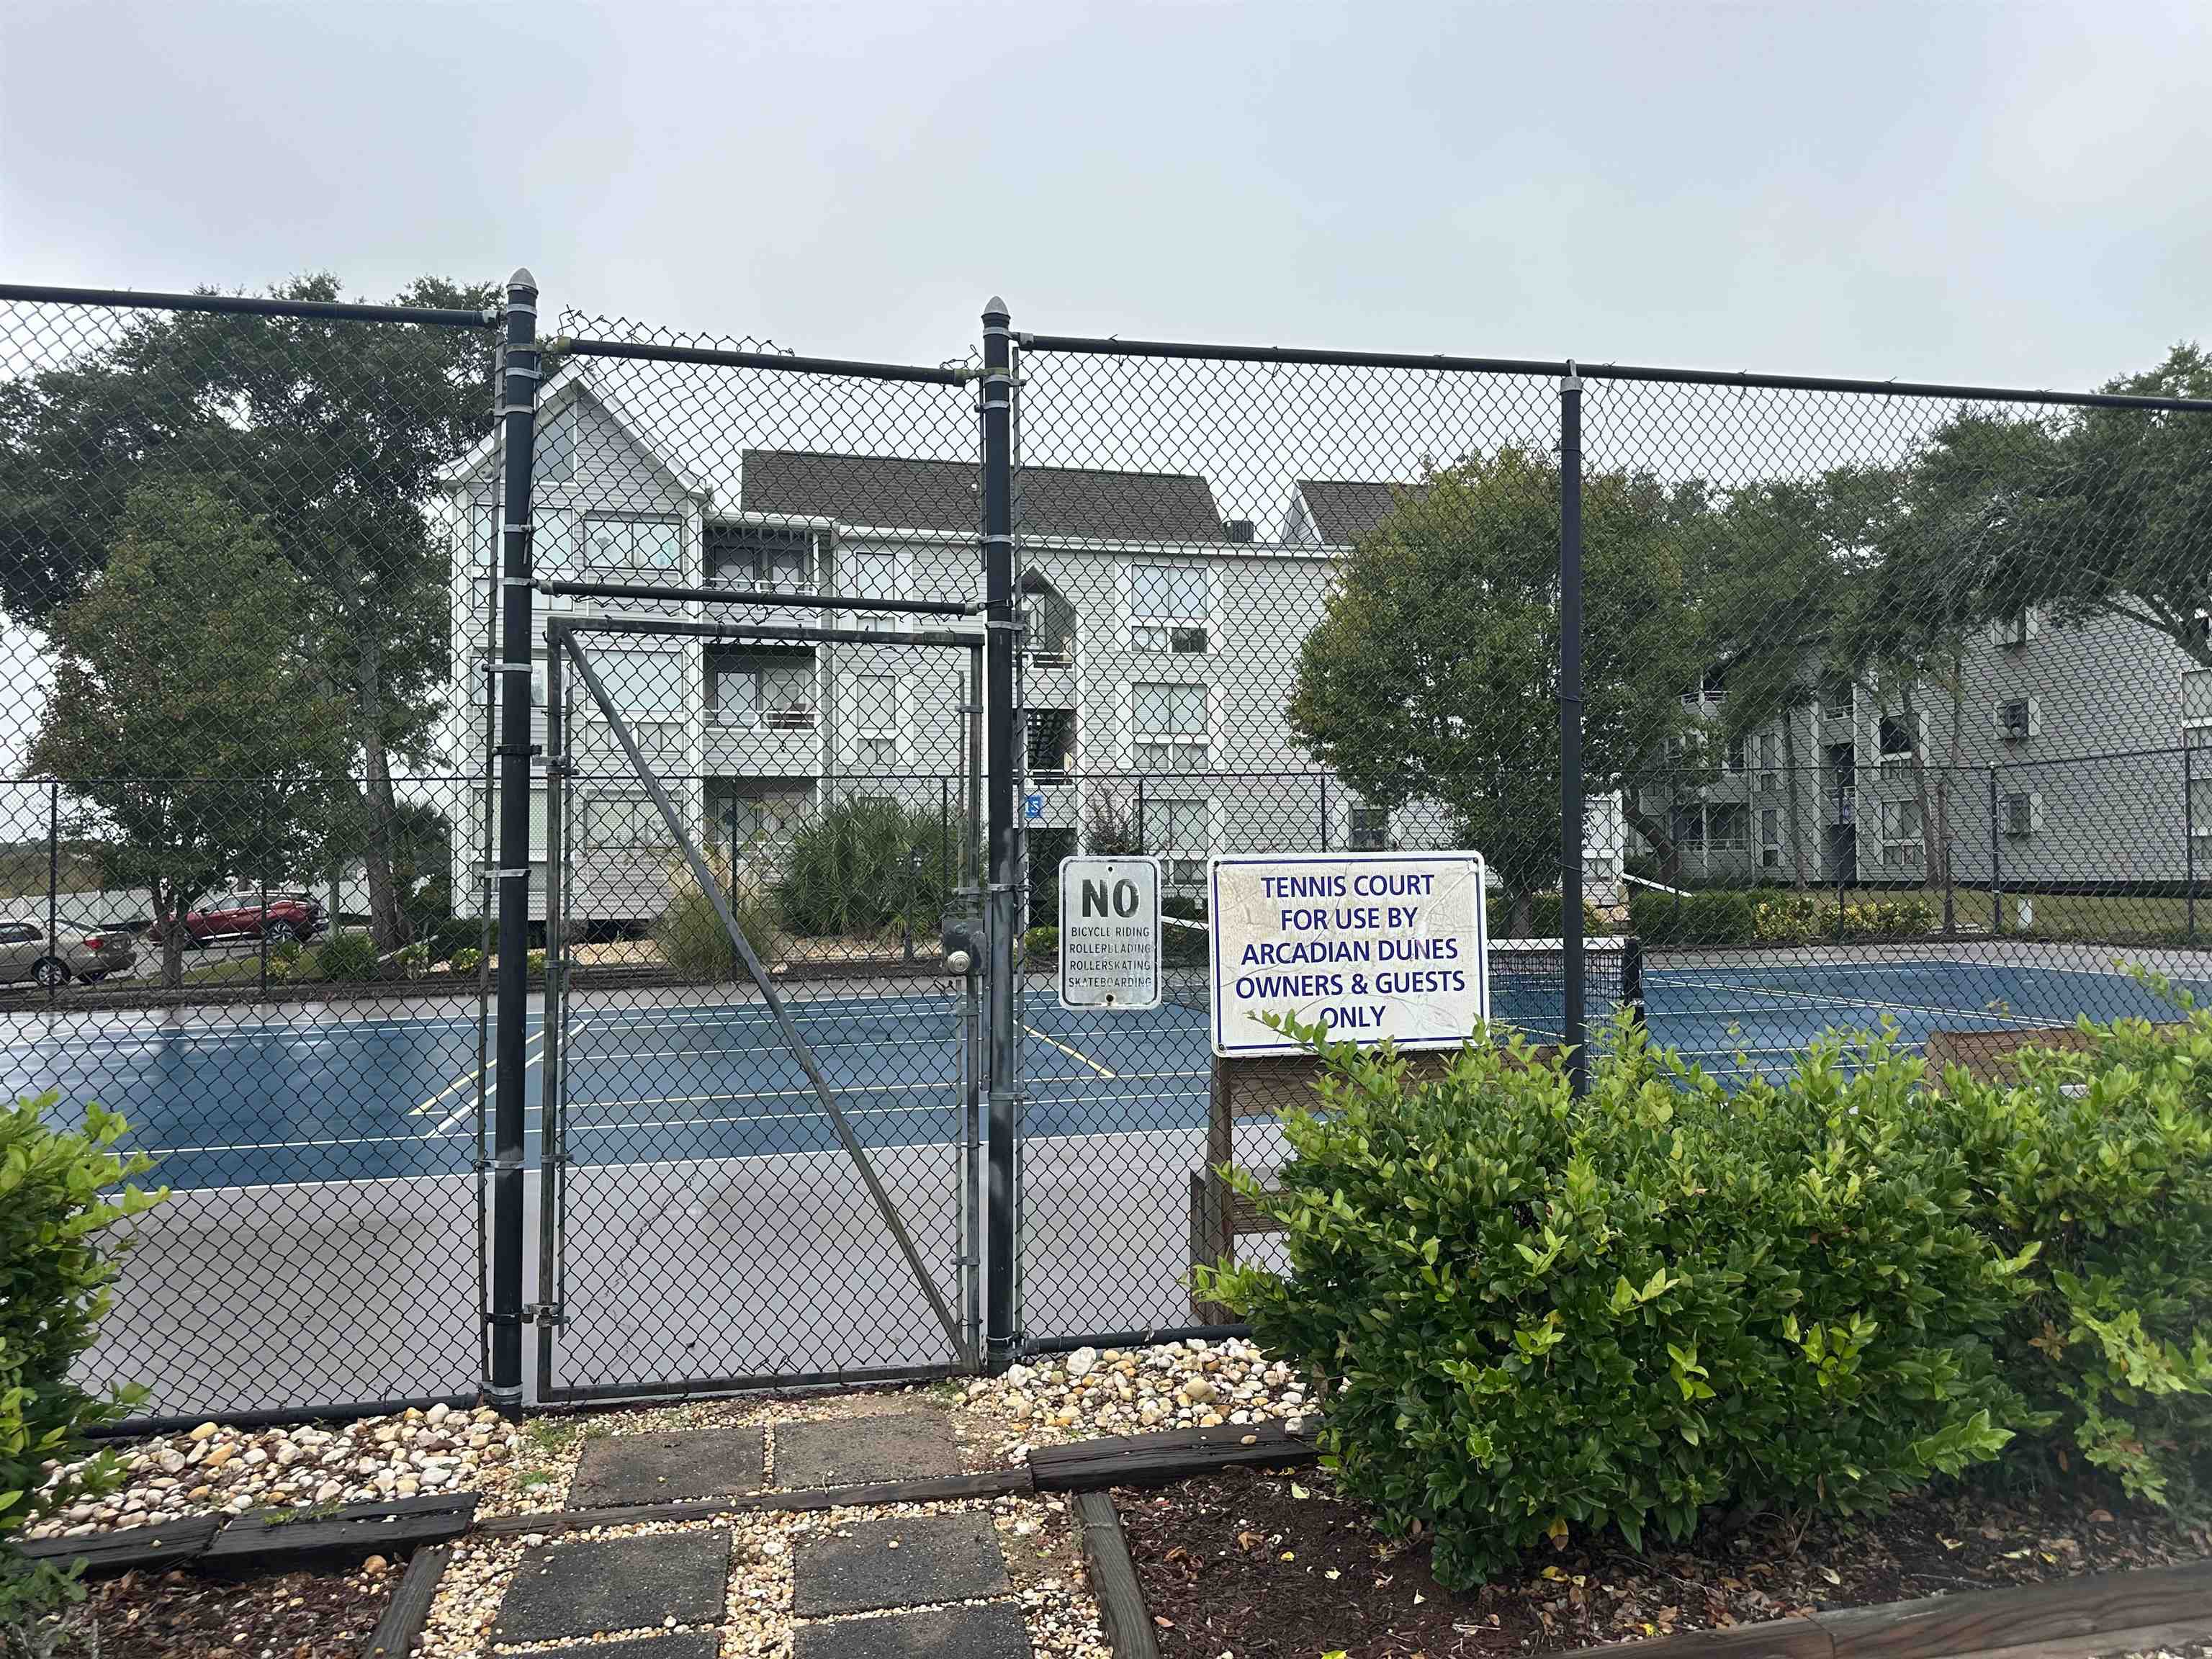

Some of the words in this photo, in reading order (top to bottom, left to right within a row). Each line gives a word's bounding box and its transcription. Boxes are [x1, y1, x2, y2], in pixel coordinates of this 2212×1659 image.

[1082, 879, 1139, 917] NO
[1261, 876, 1346, 898] TENNIS
[1354, 874, 1435, 896] COURT
[1282, 909, 1328, 931] FOR
[1336, 907, 1380, 930] USE
[1388, 907, 1419, 928] BY
[1071, 927, 1110, 937] BICYCLE
[1115, 927, 1150, 937] RIDING
[1241, 942, 1370, 965] ARCADIAN
[1378, 938, 1458, 961] DUNES
[1070, 961, 1151, 971] ROLLERSKATING
[1069, 977, 1151, 987] SKATEBOARDING
[1236, 974, 1343, 999] OWNERS
[1351, 974, 1369, 995] &
[1375, 970, 1465, 994] GUESTS
[1319, 1006, 1386, 1029] ONLY
